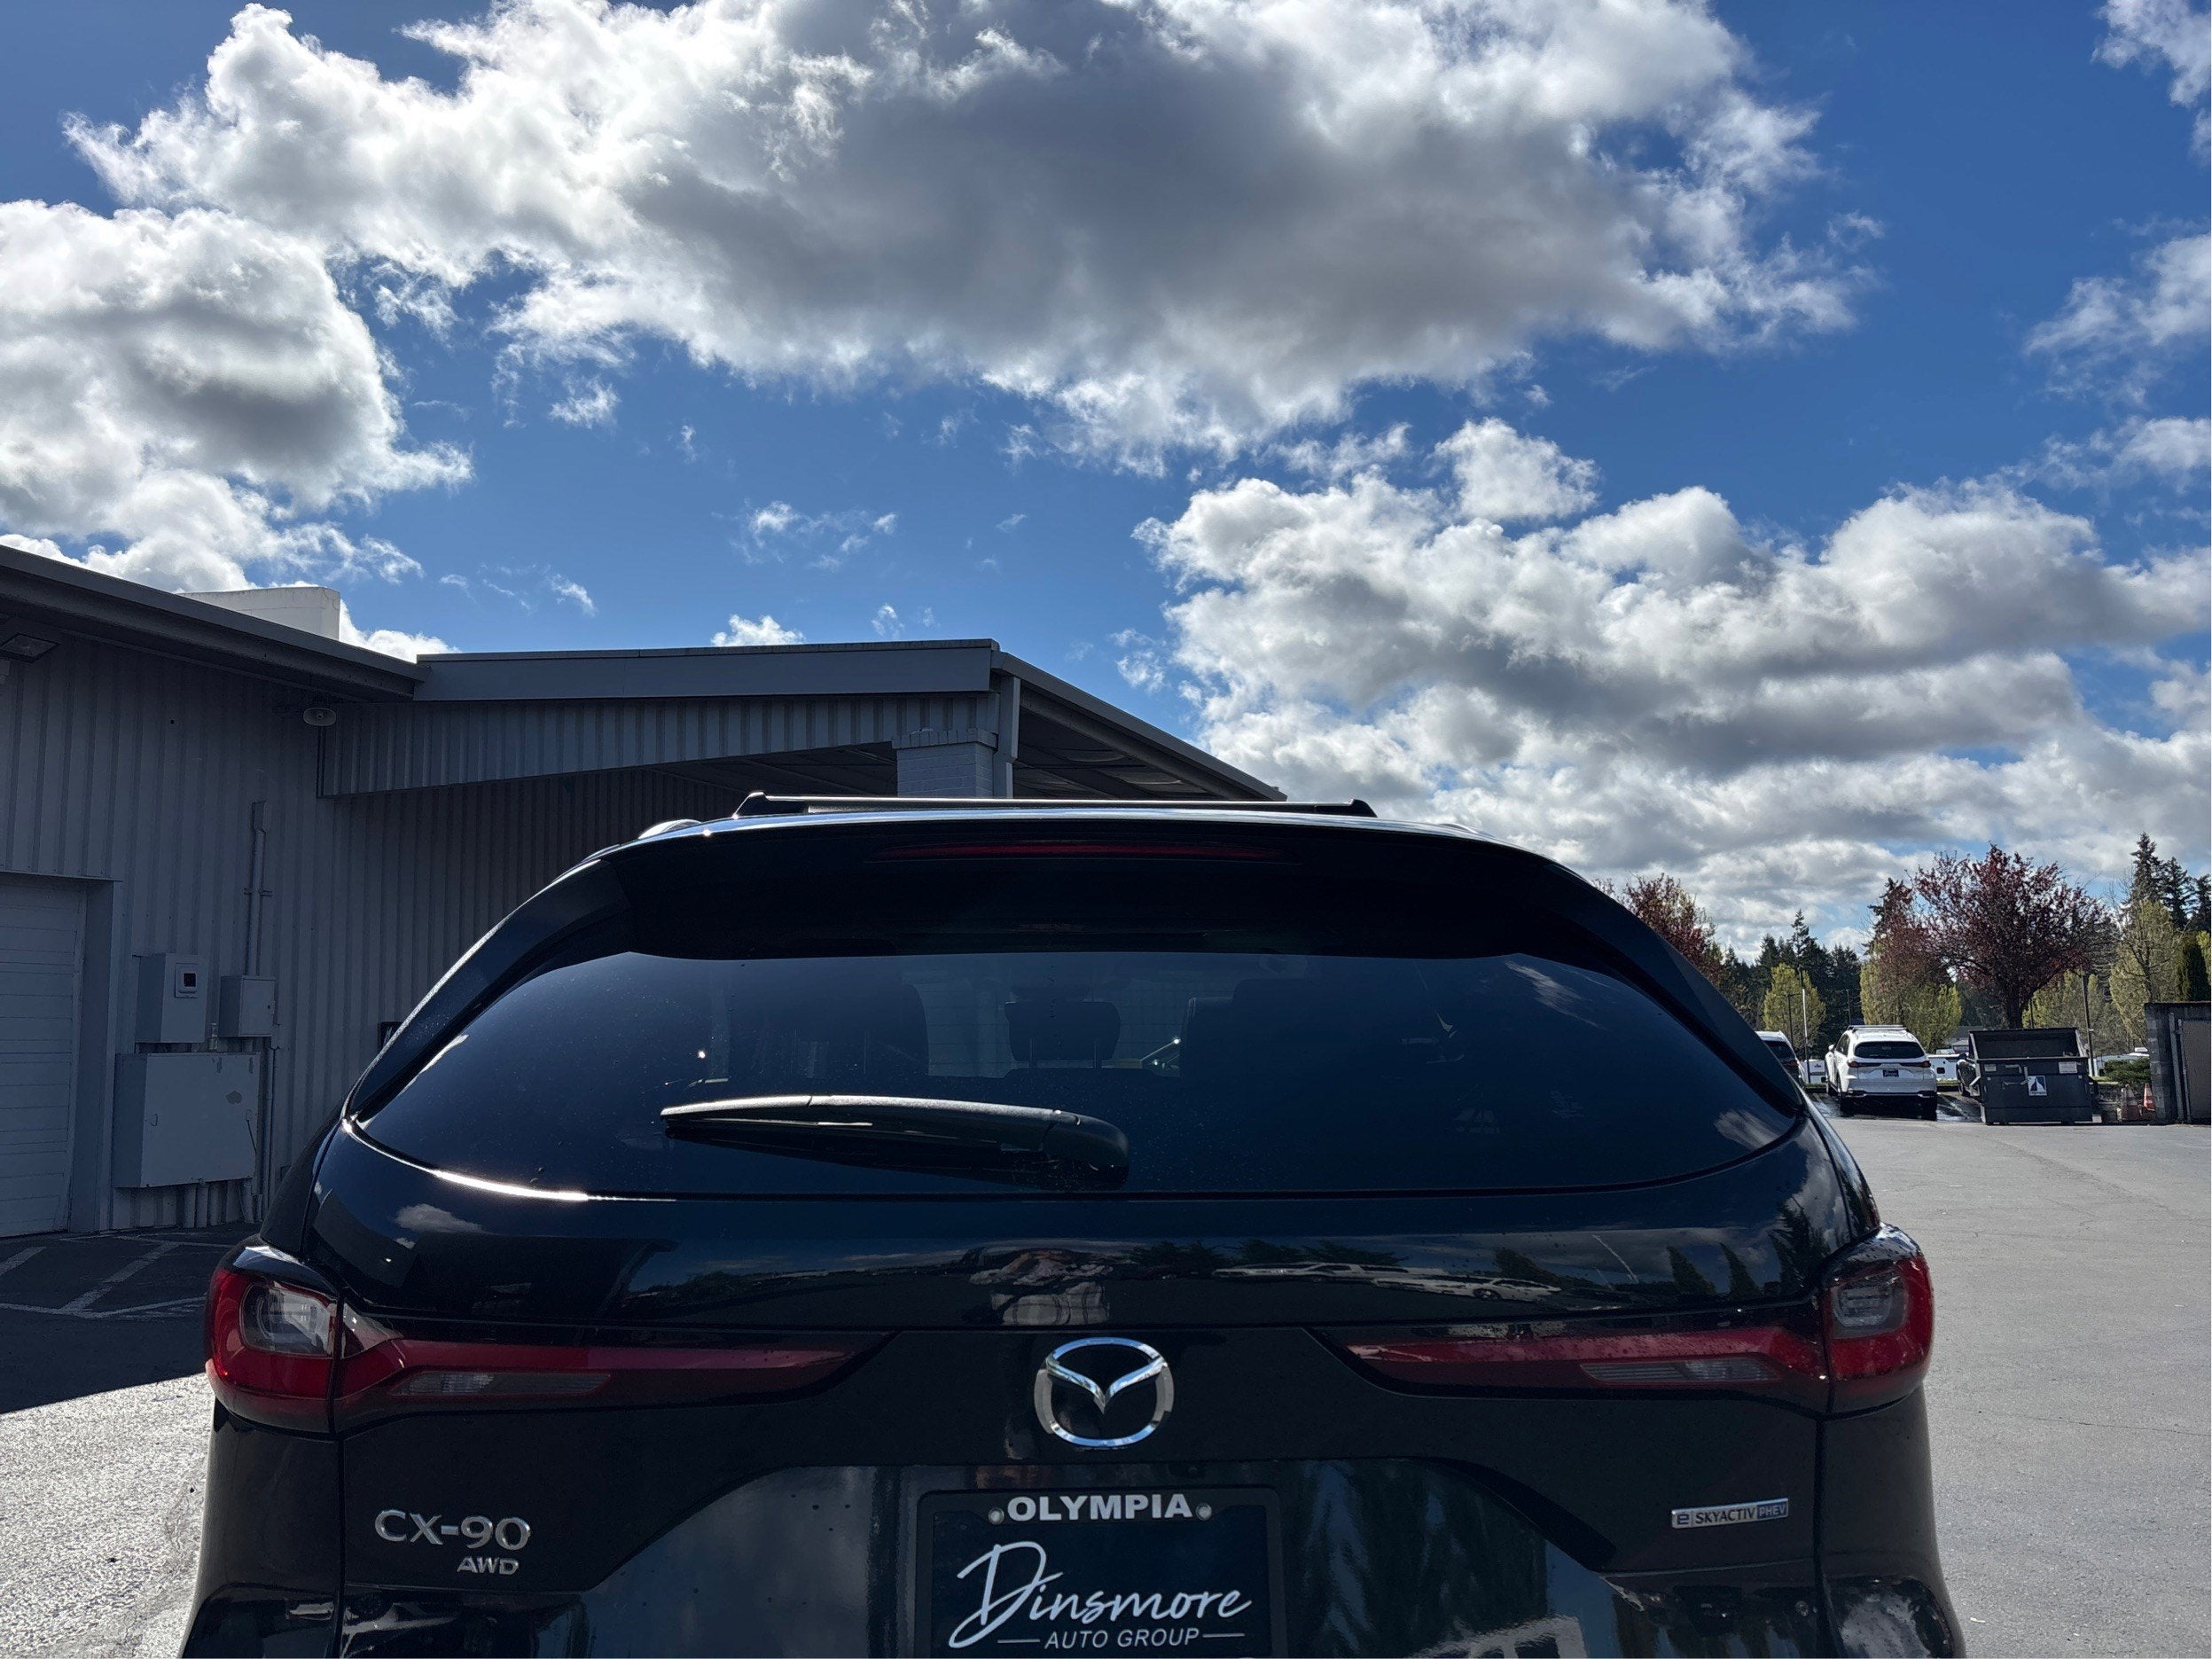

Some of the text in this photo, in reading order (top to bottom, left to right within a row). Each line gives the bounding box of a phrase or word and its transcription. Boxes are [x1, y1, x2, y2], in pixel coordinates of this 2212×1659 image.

[1007, 1493, 1193, 1522] OLYMPIA
[1695, 1507, 1755, 1524] SKYACTIV
[1759, 1504, 1786, 1517] PHEV
[374, 1509, 531, 1551] CX-90
[457, 1555, 520, 1575] AWD
[948, 1541, 1252, 1648] Dinsmore
[1044, 1628, 1200, 1649] AUTO GROUP
